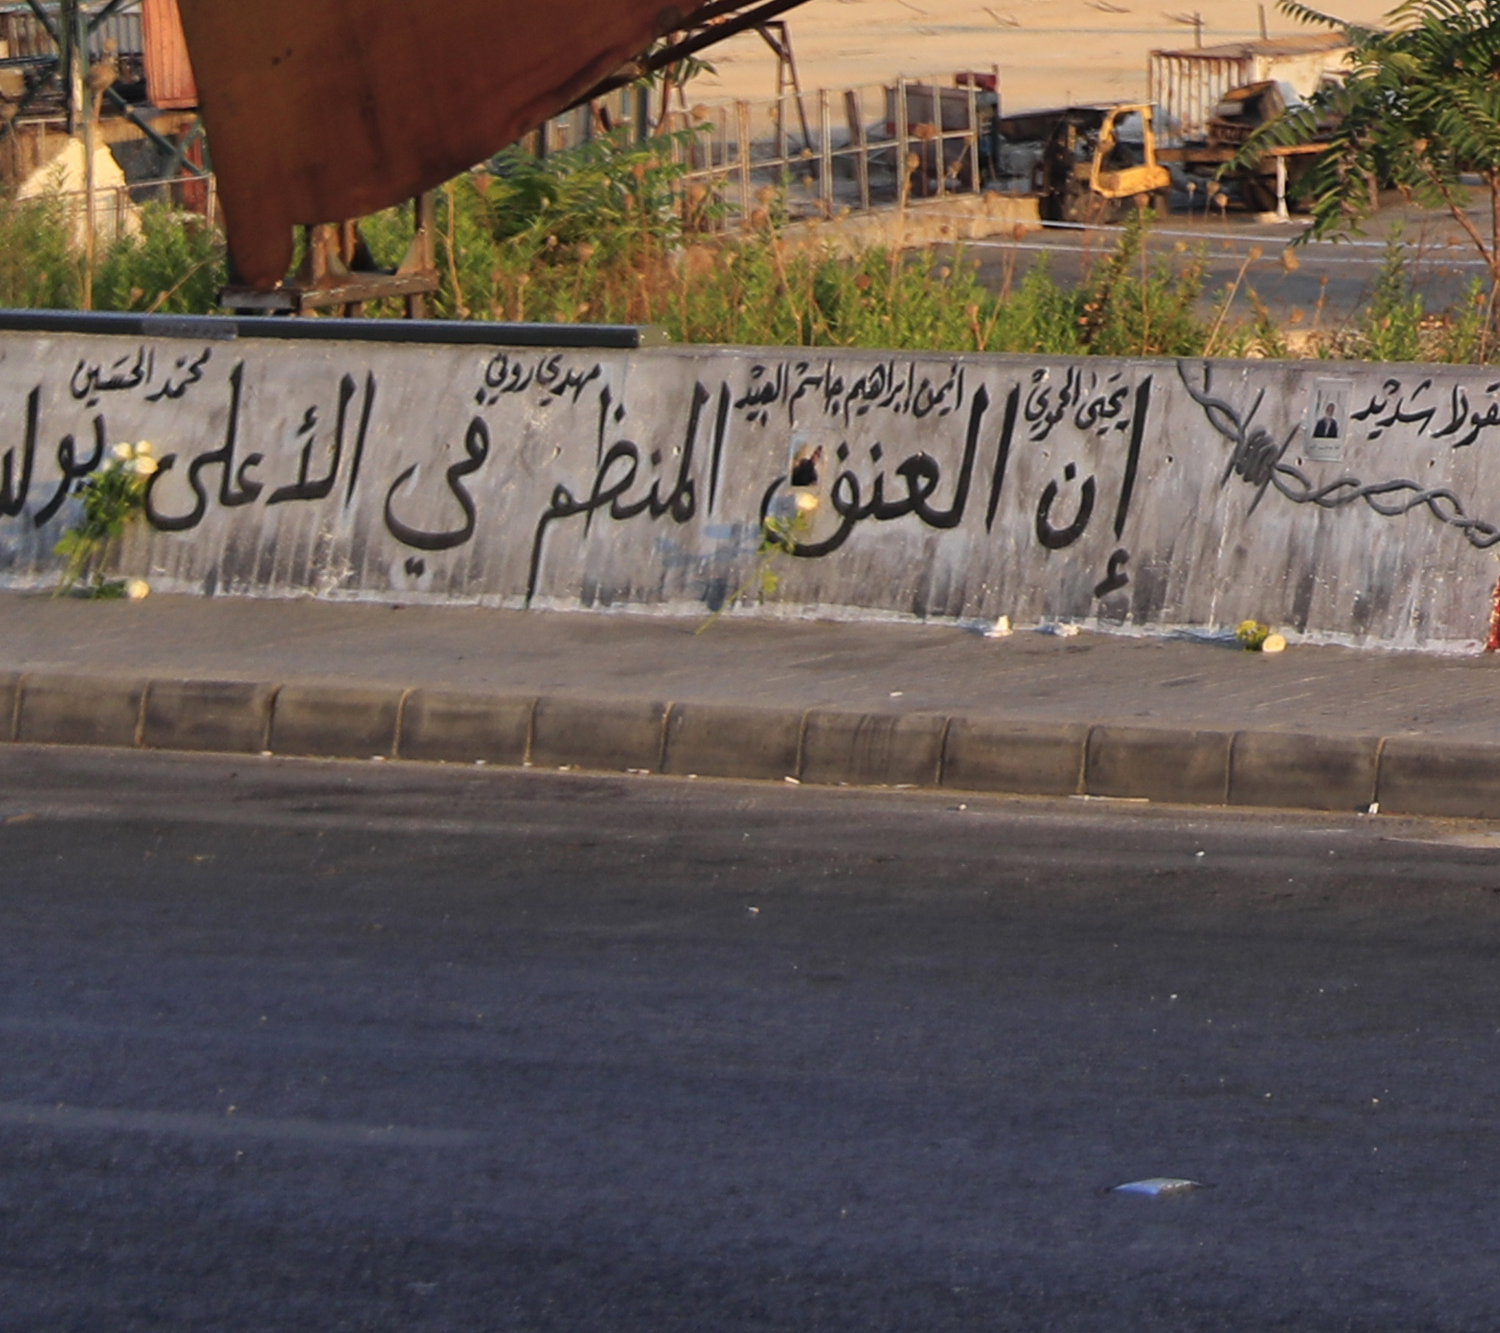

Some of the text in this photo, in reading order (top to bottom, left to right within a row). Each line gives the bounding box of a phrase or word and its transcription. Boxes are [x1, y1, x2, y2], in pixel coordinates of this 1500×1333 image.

[145, 359, 375, 532] الأعلى
[384, 386, 490, 577] في
[525, 380, 732, 611] المنظم
[759, 382, 1022, 558] العنف
[1035, 374, 1153, 599] إن
